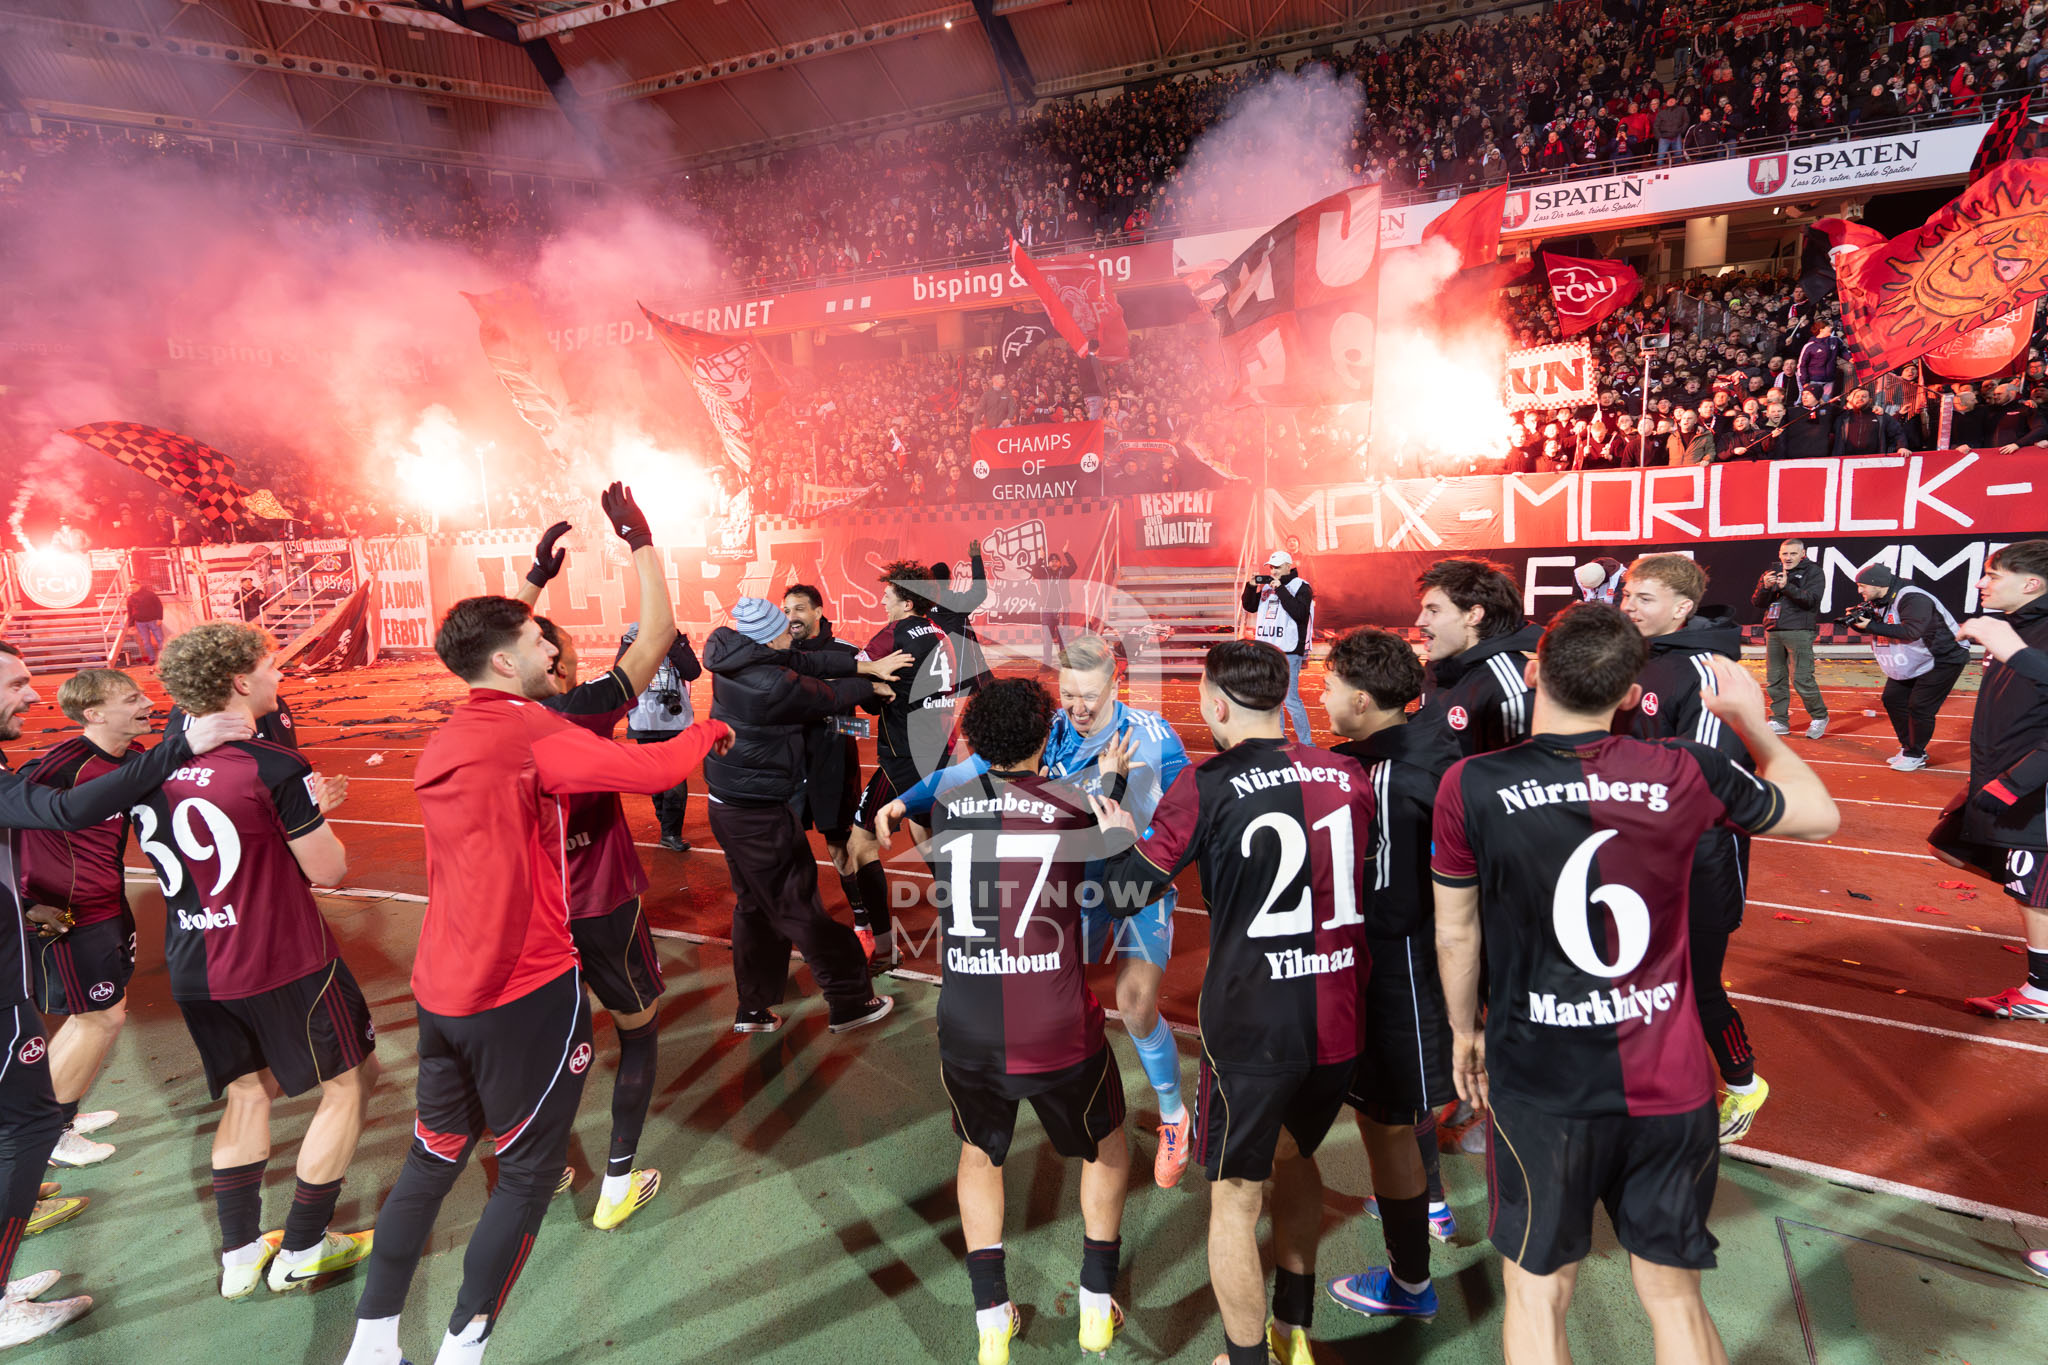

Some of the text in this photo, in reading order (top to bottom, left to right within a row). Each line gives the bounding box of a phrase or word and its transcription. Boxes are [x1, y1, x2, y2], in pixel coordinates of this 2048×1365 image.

[1793, 140, 1920, 175] SPATEN
[1811, 174, 1826, 185] Dir
[1854, 169, 1879, 179] trinke
[1881, 162, 1917, 178] Spaten!
[1535, 179, 1645, 211] SPATEN
[1551, 210, 1565, 220] Dir
[1588, 204, 1609, 215] trinke
[1611, 199, 1643, 213] Spaten!
[913, 264, 1028, 302] bisping &
[1552, 281, 1608, 302] FCN
[167, 336, 273, 367] bisping
[997, 433, 1071, 454] CHAMPS
[1022, 459, 1046, 475] OF
[992, 480, 1077, 500] GERMANY
[1140, 491, 1215, 517] RESPEKT
[1144, 518, 1212, 547] RIVALITÄT
[363, 540, 422, 572] SEKTION
[36, 575, 78, 592] FCN
[381, 580, 425, 609] ADION
[1003, 596, 1036, 615] 1994
[383, 617, 427, 646] ERBOT
[1257, 625, 1284, 638] CLUB
[929, 640, 953, 692] 4
[922, 695, 956, 710] Gruber
[1230, 761, 1351, 799] Nürnberg
[1497, 773, 1669, 815] Nürnberg
[947, 792, 1058, 823] Nürnberg
[129, 797, 242, 898] 39
[940, 832, 1061, 939] 17
[1241, 804, 1365, 938] 21
[1552, 829, 1651, 978] 6
[947, 947, 1061, 975] Chaikhoun
[1264, 946, 1355, 980] Yilmaz
